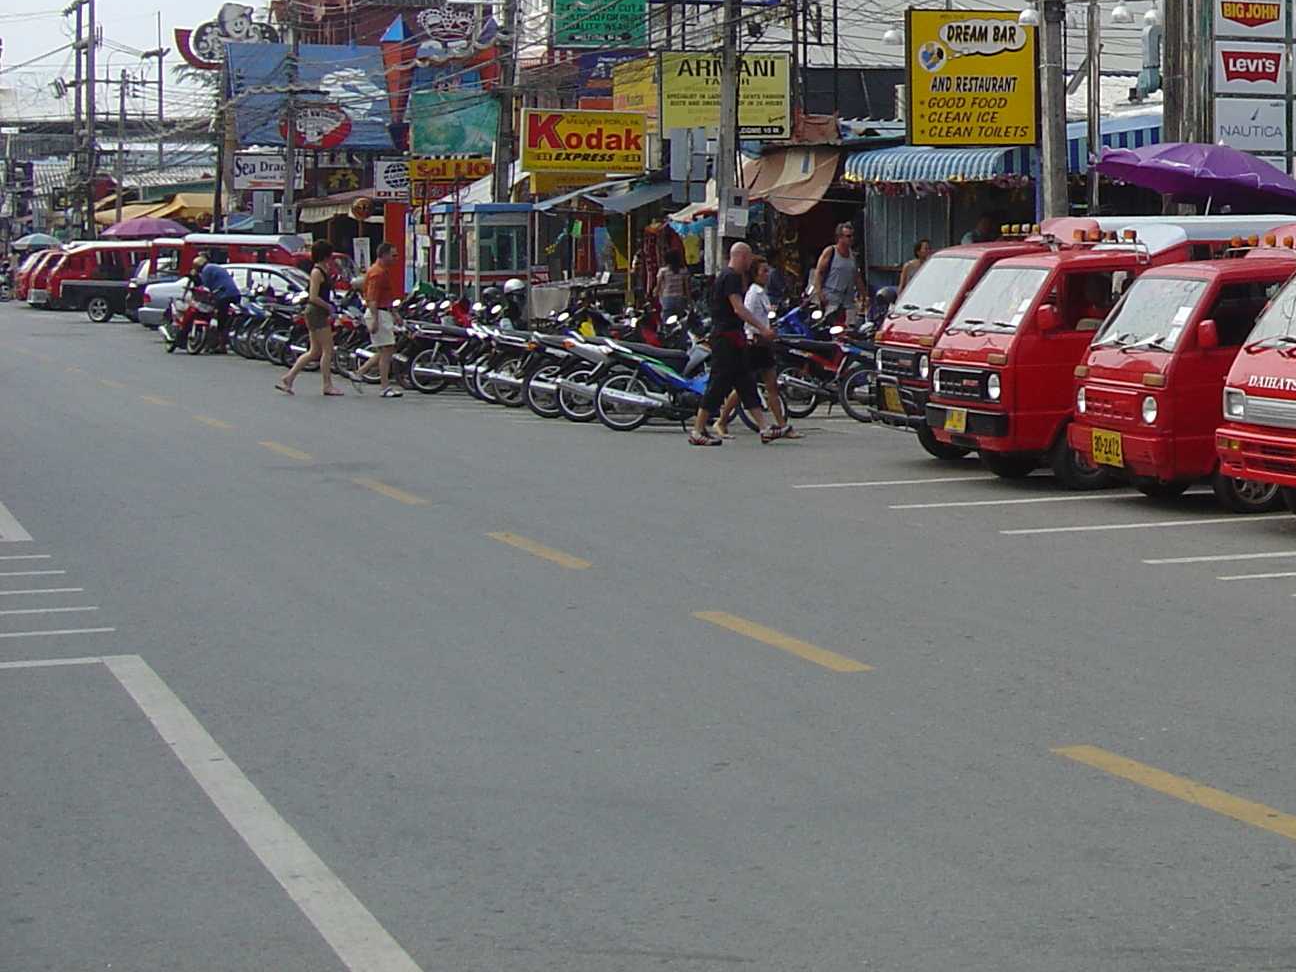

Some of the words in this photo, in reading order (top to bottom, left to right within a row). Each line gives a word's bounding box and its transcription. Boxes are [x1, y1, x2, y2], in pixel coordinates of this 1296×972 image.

[1223, 3, 1245, 18] BIG
[1246, 4, 1279, 20] JOHN
[946, 24, 988, 43] DREAM
[992, 25, 1017, 44] BAR
[930, 76, 952, 92] AND
[955, 76, 1018, 93] RESTAURANT
[927, 97, 966, 109] GOOD
[970, 97, 1008, 109] FOOD
[927, 111, 972, 123] CLEAN
[976, 112, 999, 123] ICE
[527, 113, 643, 152] Kodak
[928, 126, 973, 138] CLEAN
[978, 126, 1029, 138] TOILETS
[1220, 125, 1283, 138] NAUTICA
[554, 152, 616, 162] EXPRESS
[234, 157, 256, 178] Sea
[383, 172, 410, 180] KUON
